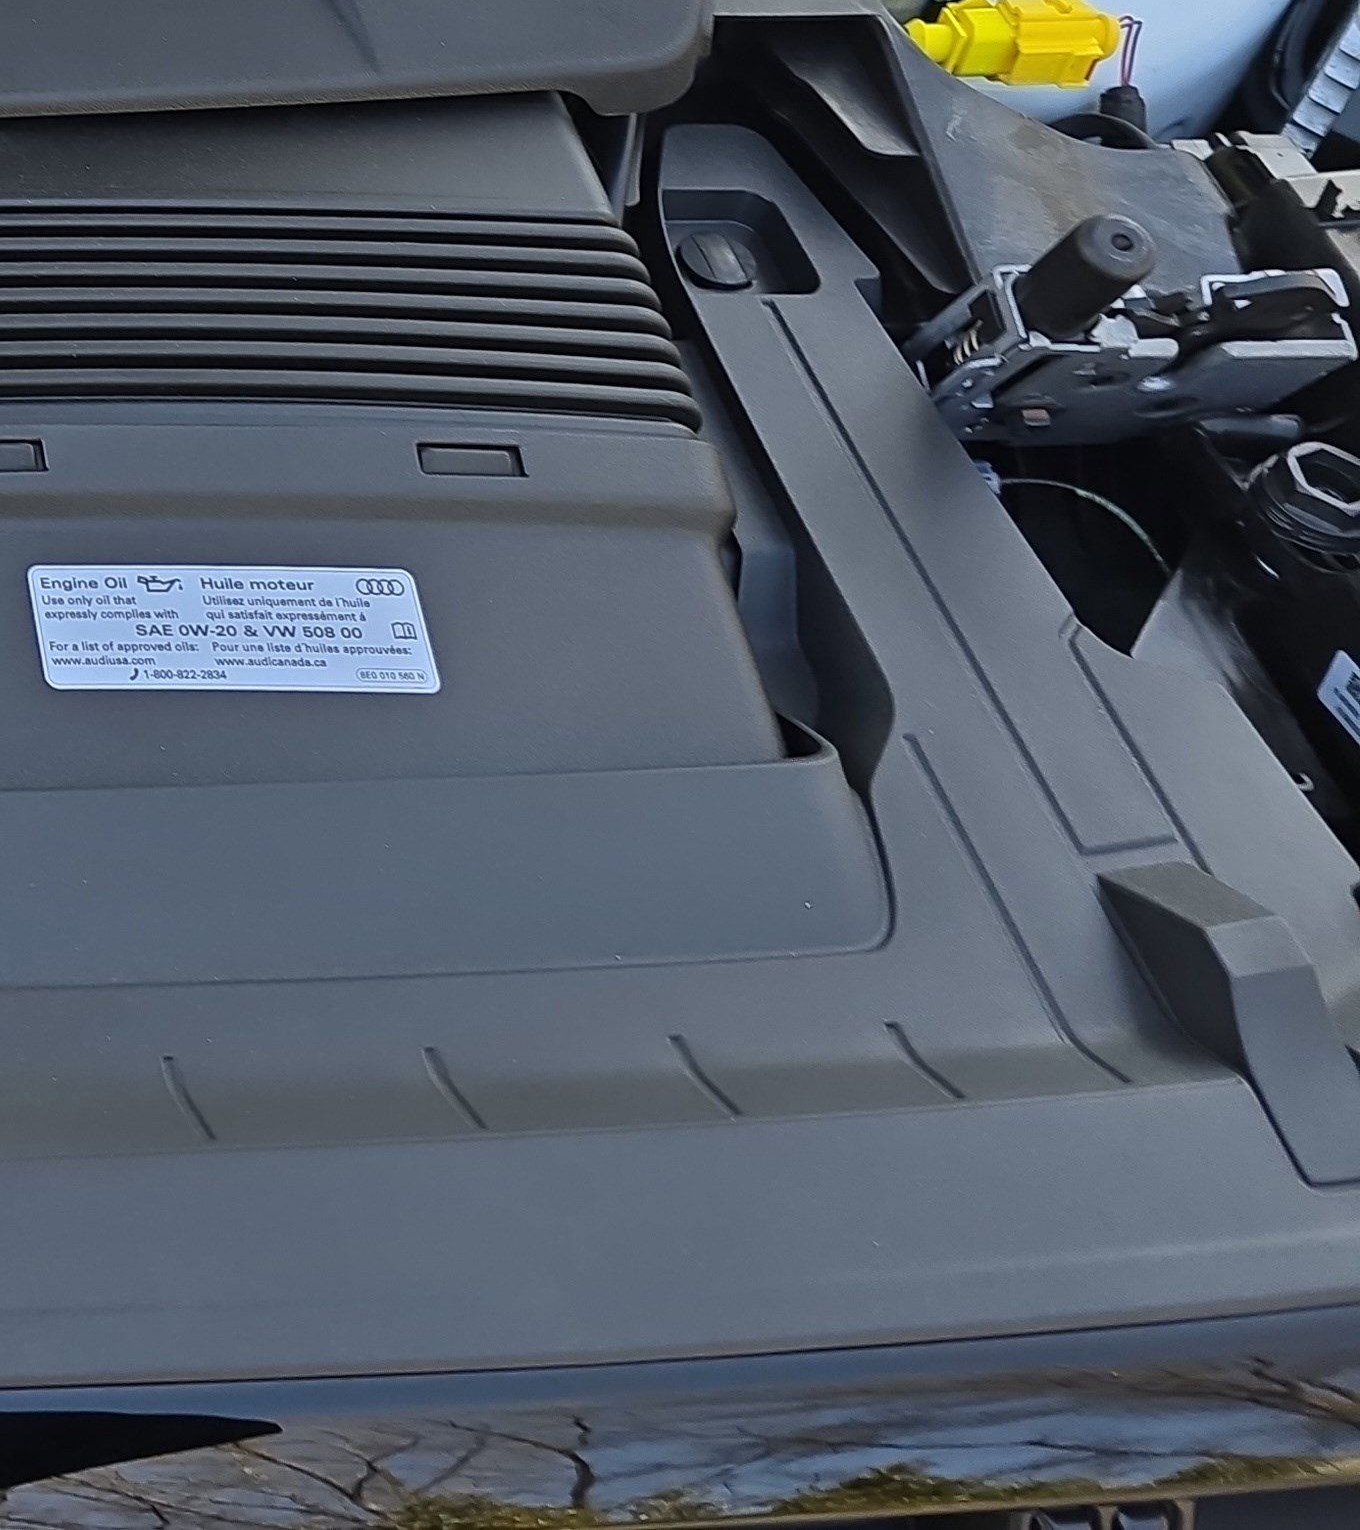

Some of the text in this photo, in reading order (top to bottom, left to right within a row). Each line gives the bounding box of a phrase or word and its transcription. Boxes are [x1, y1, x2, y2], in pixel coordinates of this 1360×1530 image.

[40, 576, 128, 592] Engine Oil
[200, 577, 314, 591] Huile moteur
[41, 595, 137, 607] Use only oil that
[202, 595, 245, 606] Utilisez
[247, 596, 317, 608] uniquement
[318, 597, 333, 607] de
[44, 608, 179, 621] expressly complies with
[206, 610, 225, 621] qui
[227, 609, 274, 620] satisfait
[275, 611, 357, 622] expressément
[135, 624, 363, 639] SAE 0W-20 & VW 508 00
[49, 641, 199, 653] For a list of approved oils:
[211, 642, 239, 652] Pour
[242, 644, 264, 653] une
[267, 642, 292, 653] liste
[51, 656, 156, 666] www.audiusa.com
[214, 656, 328, 668] www.audicanada.ca
[143, 670, 227, 680] 1-800-822-2834
[379, 671, 397, 680] 010
[416, 672, 425, 681] N
